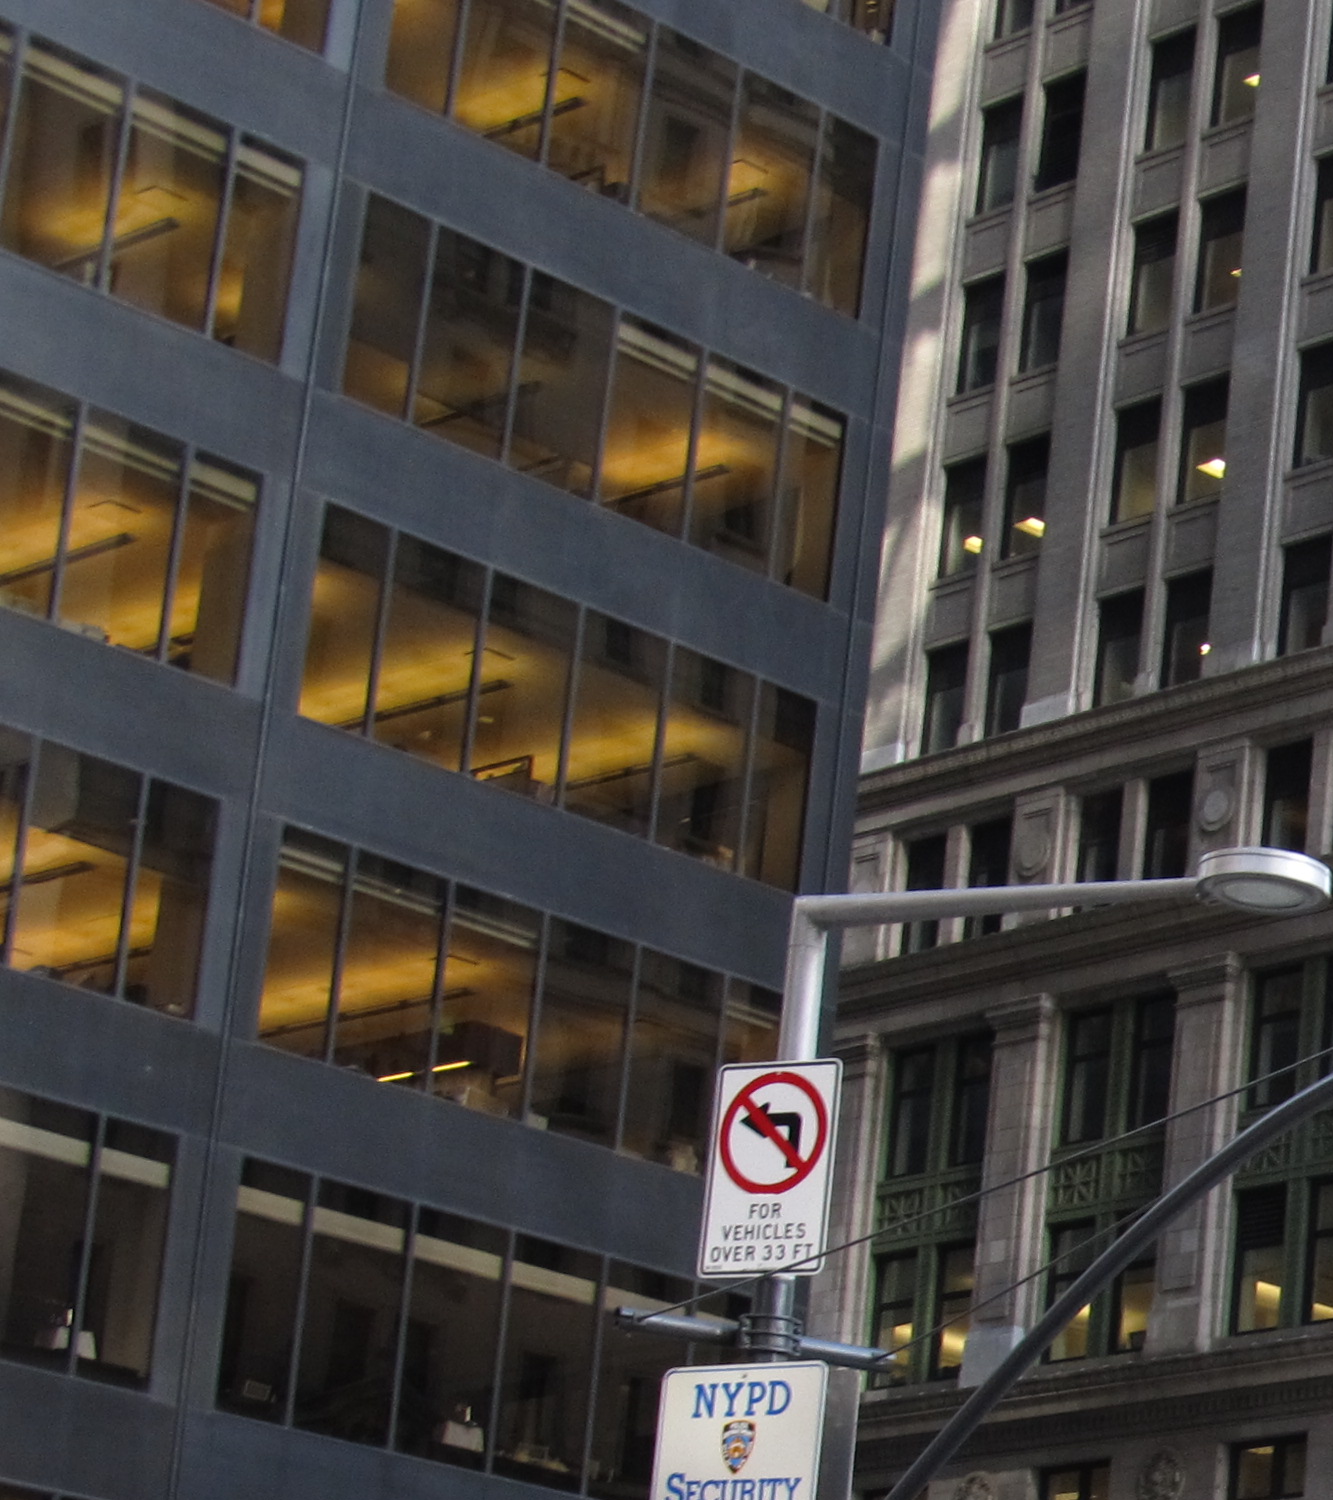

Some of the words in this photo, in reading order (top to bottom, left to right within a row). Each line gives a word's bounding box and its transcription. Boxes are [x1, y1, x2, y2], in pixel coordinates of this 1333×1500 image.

[748, 1203, 782, 1220] FOR
[722, 1223, 807, 1241] VEHICLES
[710, 1245, 756, 1263] OVER
[762, 1244, 786, 1261] 33
[792, 1243, 813, 1260] FT
[692, 1380, 792, 1419] NYPD
